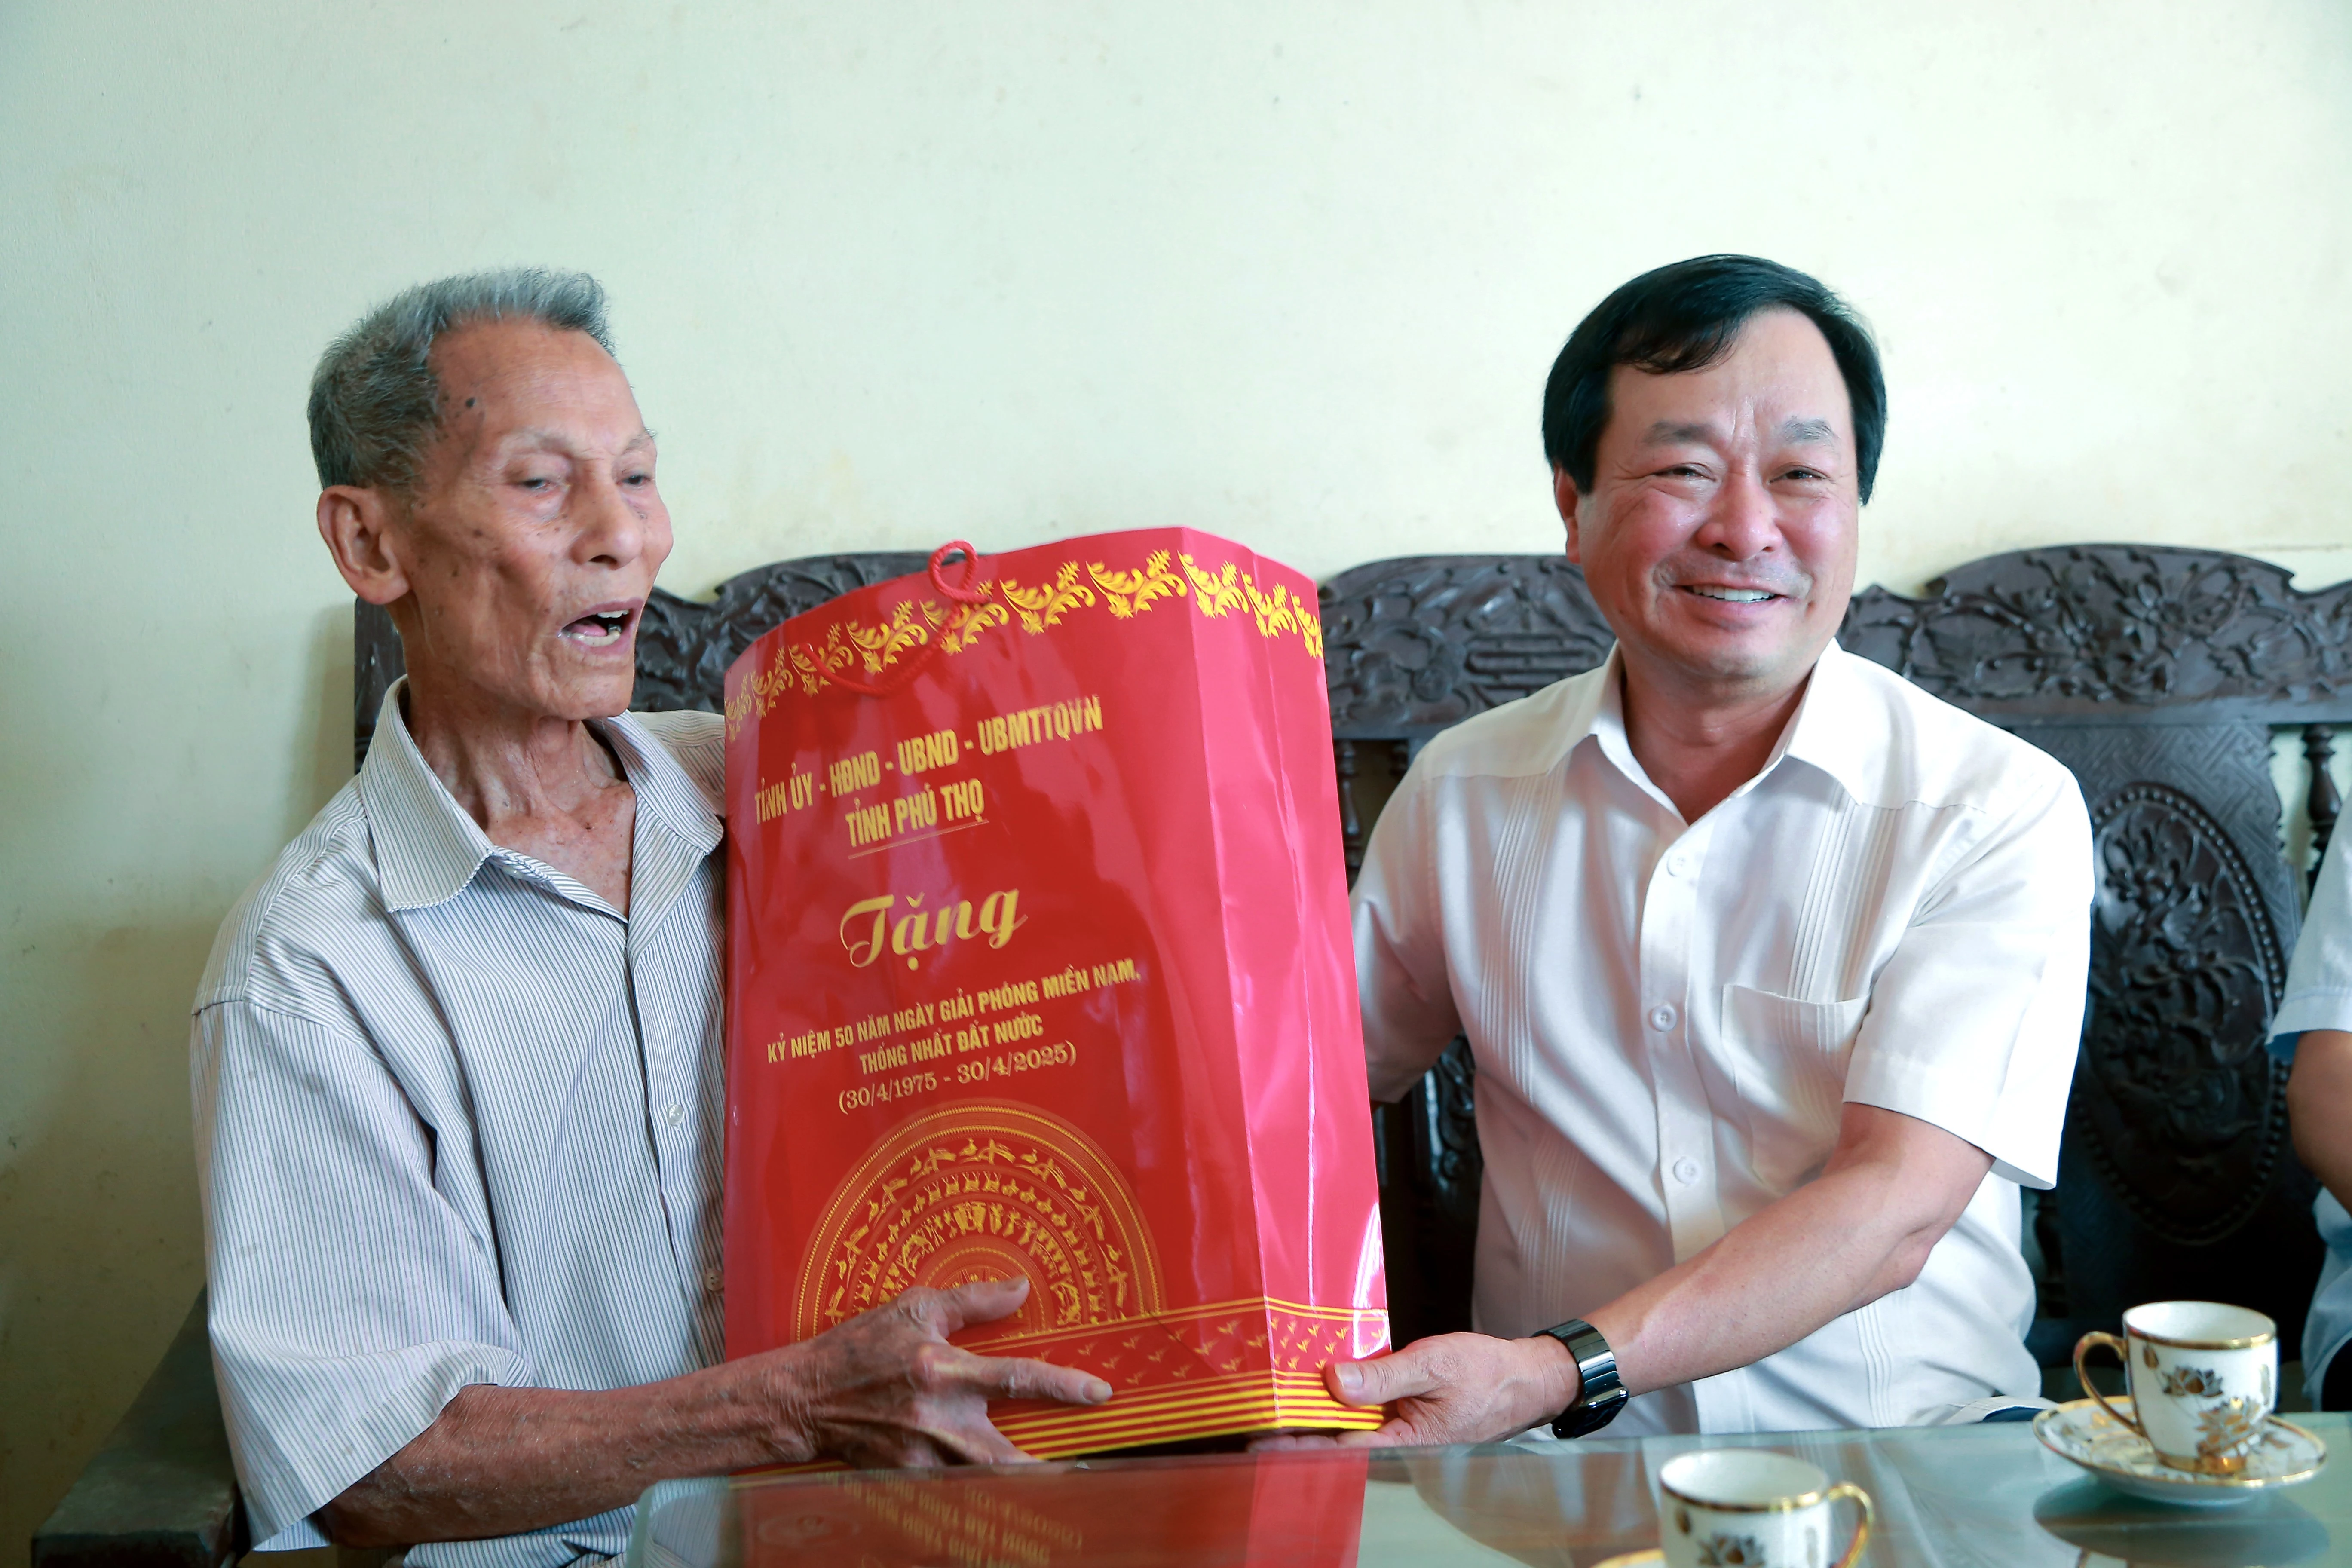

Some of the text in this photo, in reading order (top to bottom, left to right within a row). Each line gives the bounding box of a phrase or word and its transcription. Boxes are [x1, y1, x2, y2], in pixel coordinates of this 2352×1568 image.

[755, 694, 1103, 825] TỈNH ỦY - HĐND - UBND - UBMTTQVN
[845, 778, 985, 847] TỈNH PHÚ THỌ
[839, 888, 1029, 971] Tặng
[767, 1032, 786, 1063] KỶ
[790, 1029, 831, 1059] NIỆM
[835, 1025, 854, 1048] 50
[856, 1014, 891, 1043] NĂM
[893, 1002, 934, 1033] NGÀY
[939, 987, 975, 1022] GIẢI
[977, 980, 1040, 1014] PHÓNG
[1041, 963, 1090, 1000] MIỀN
[859, 1011, 1044, 1075] THỐNG NHẤT ĐẤT NƯỚC
[838, 1071, 938, 1115] (30/4/1975
[956, 1040, 1077, 1084] 30/4/2025)
